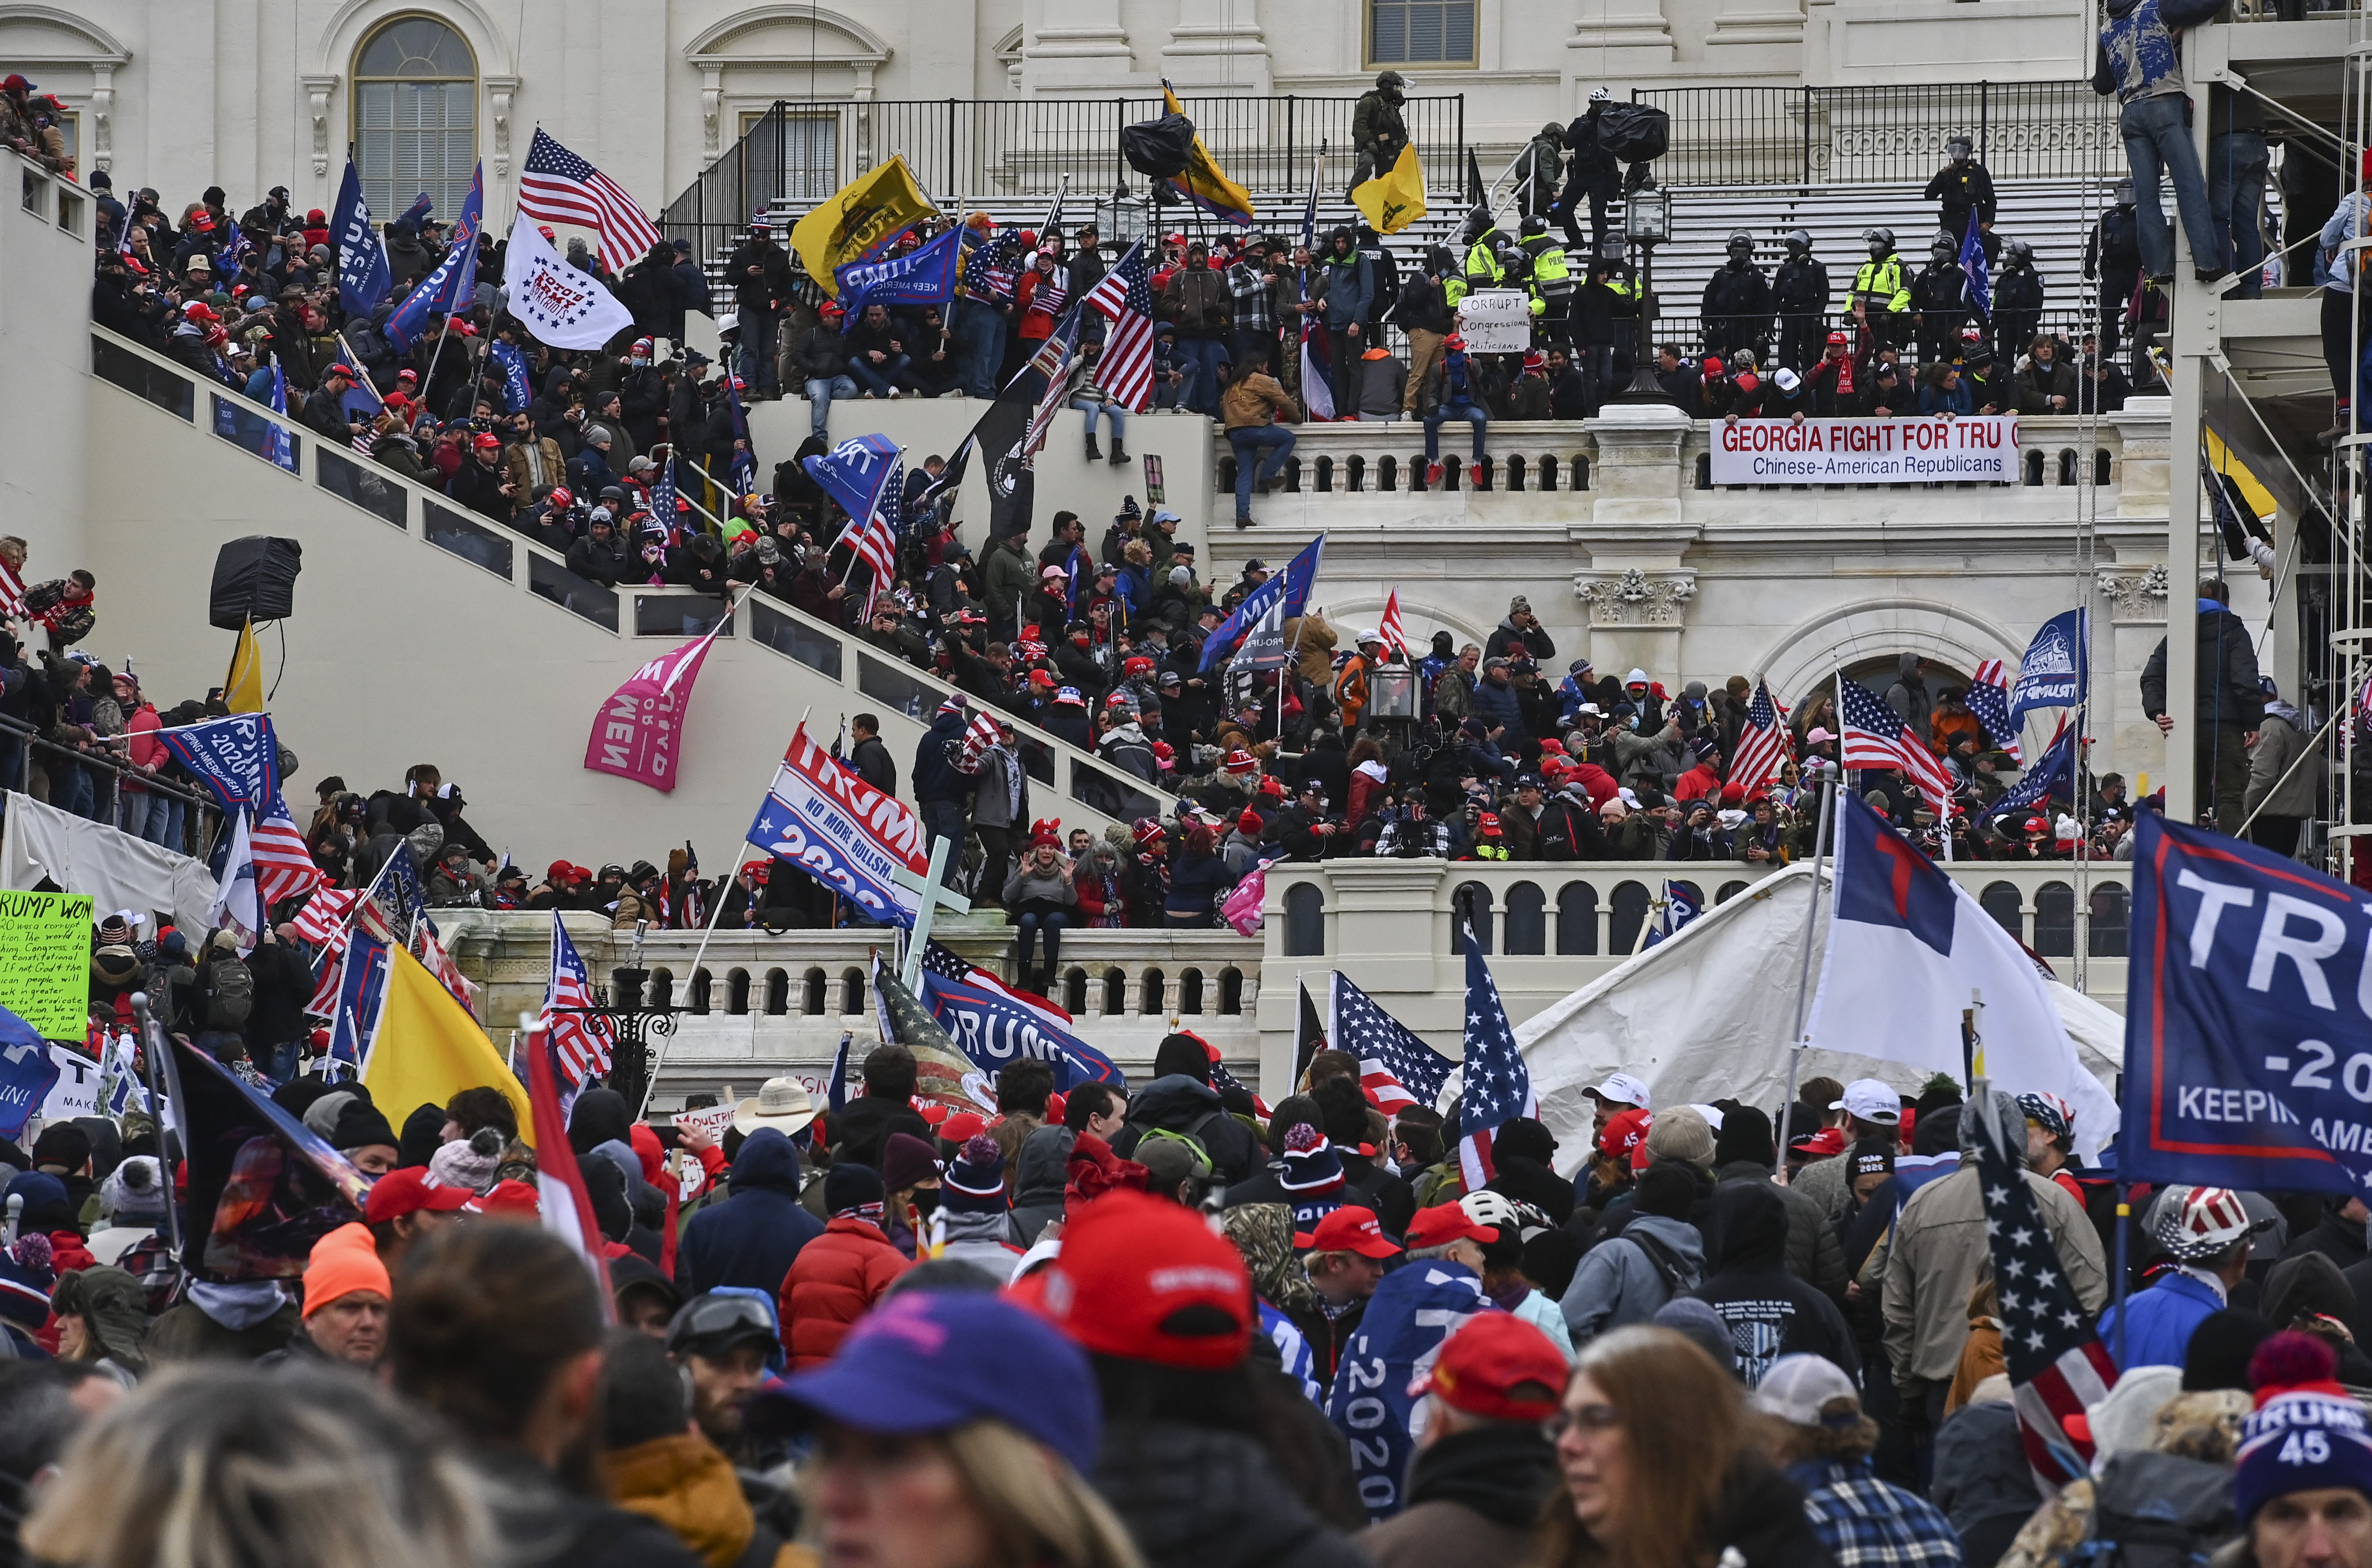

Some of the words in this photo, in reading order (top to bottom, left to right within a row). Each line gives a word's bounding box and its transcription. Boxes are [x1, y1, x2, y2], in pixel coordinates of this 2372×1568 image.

[534, 274, 576, 309] ARMY
[541, 268, 585, 302] TOTO'S
[533, 287, 569, 319] PATRIOTS
[1460, 298, 1521, 312] CORRUPT
[1722, 425, 1823, 452] GEORGIA
[1830, 425, 1893, 452] FIGHT
[1903, 423, 1949, 450] FOR
[1753, 455, 1899, 475] Chinese-American
[1905, 454, 2001, 477] Republicans
[181, 731, 202, 753] KEEPING
[805, 796, 825, 817] NO
[823, 812, 853, 845] MORE
[851, 838, 895, 885] BULLSH
[0, 893, 55, 919] RUMP
[60, 899, 91, 920] WON
[26, 931, 40, 941] The
[46, 930, 73, 940] world
[44, 923, 80, 932] corrupt
[2, 962, 16, 973] If
[35, 962, 56, 973] God
[26, 977, 54, 987] people
[61, 974, 79, 983] will
[31, 985, 63, 1000] greater
[37, 1023, 49, 1033] be
[56, 1023, 77, 1033] lost.
[946, 1007, 1090, 1075] TRUM
[1624, 1131, 1639, 1147] 45
[682, 1159, 699, 1168] THE
[1858, 1155, 1883, 1163] TRUMP
[1860, 1163, 1883, 1173] 2020
[2277, 1429, 2331, 1467] 45
